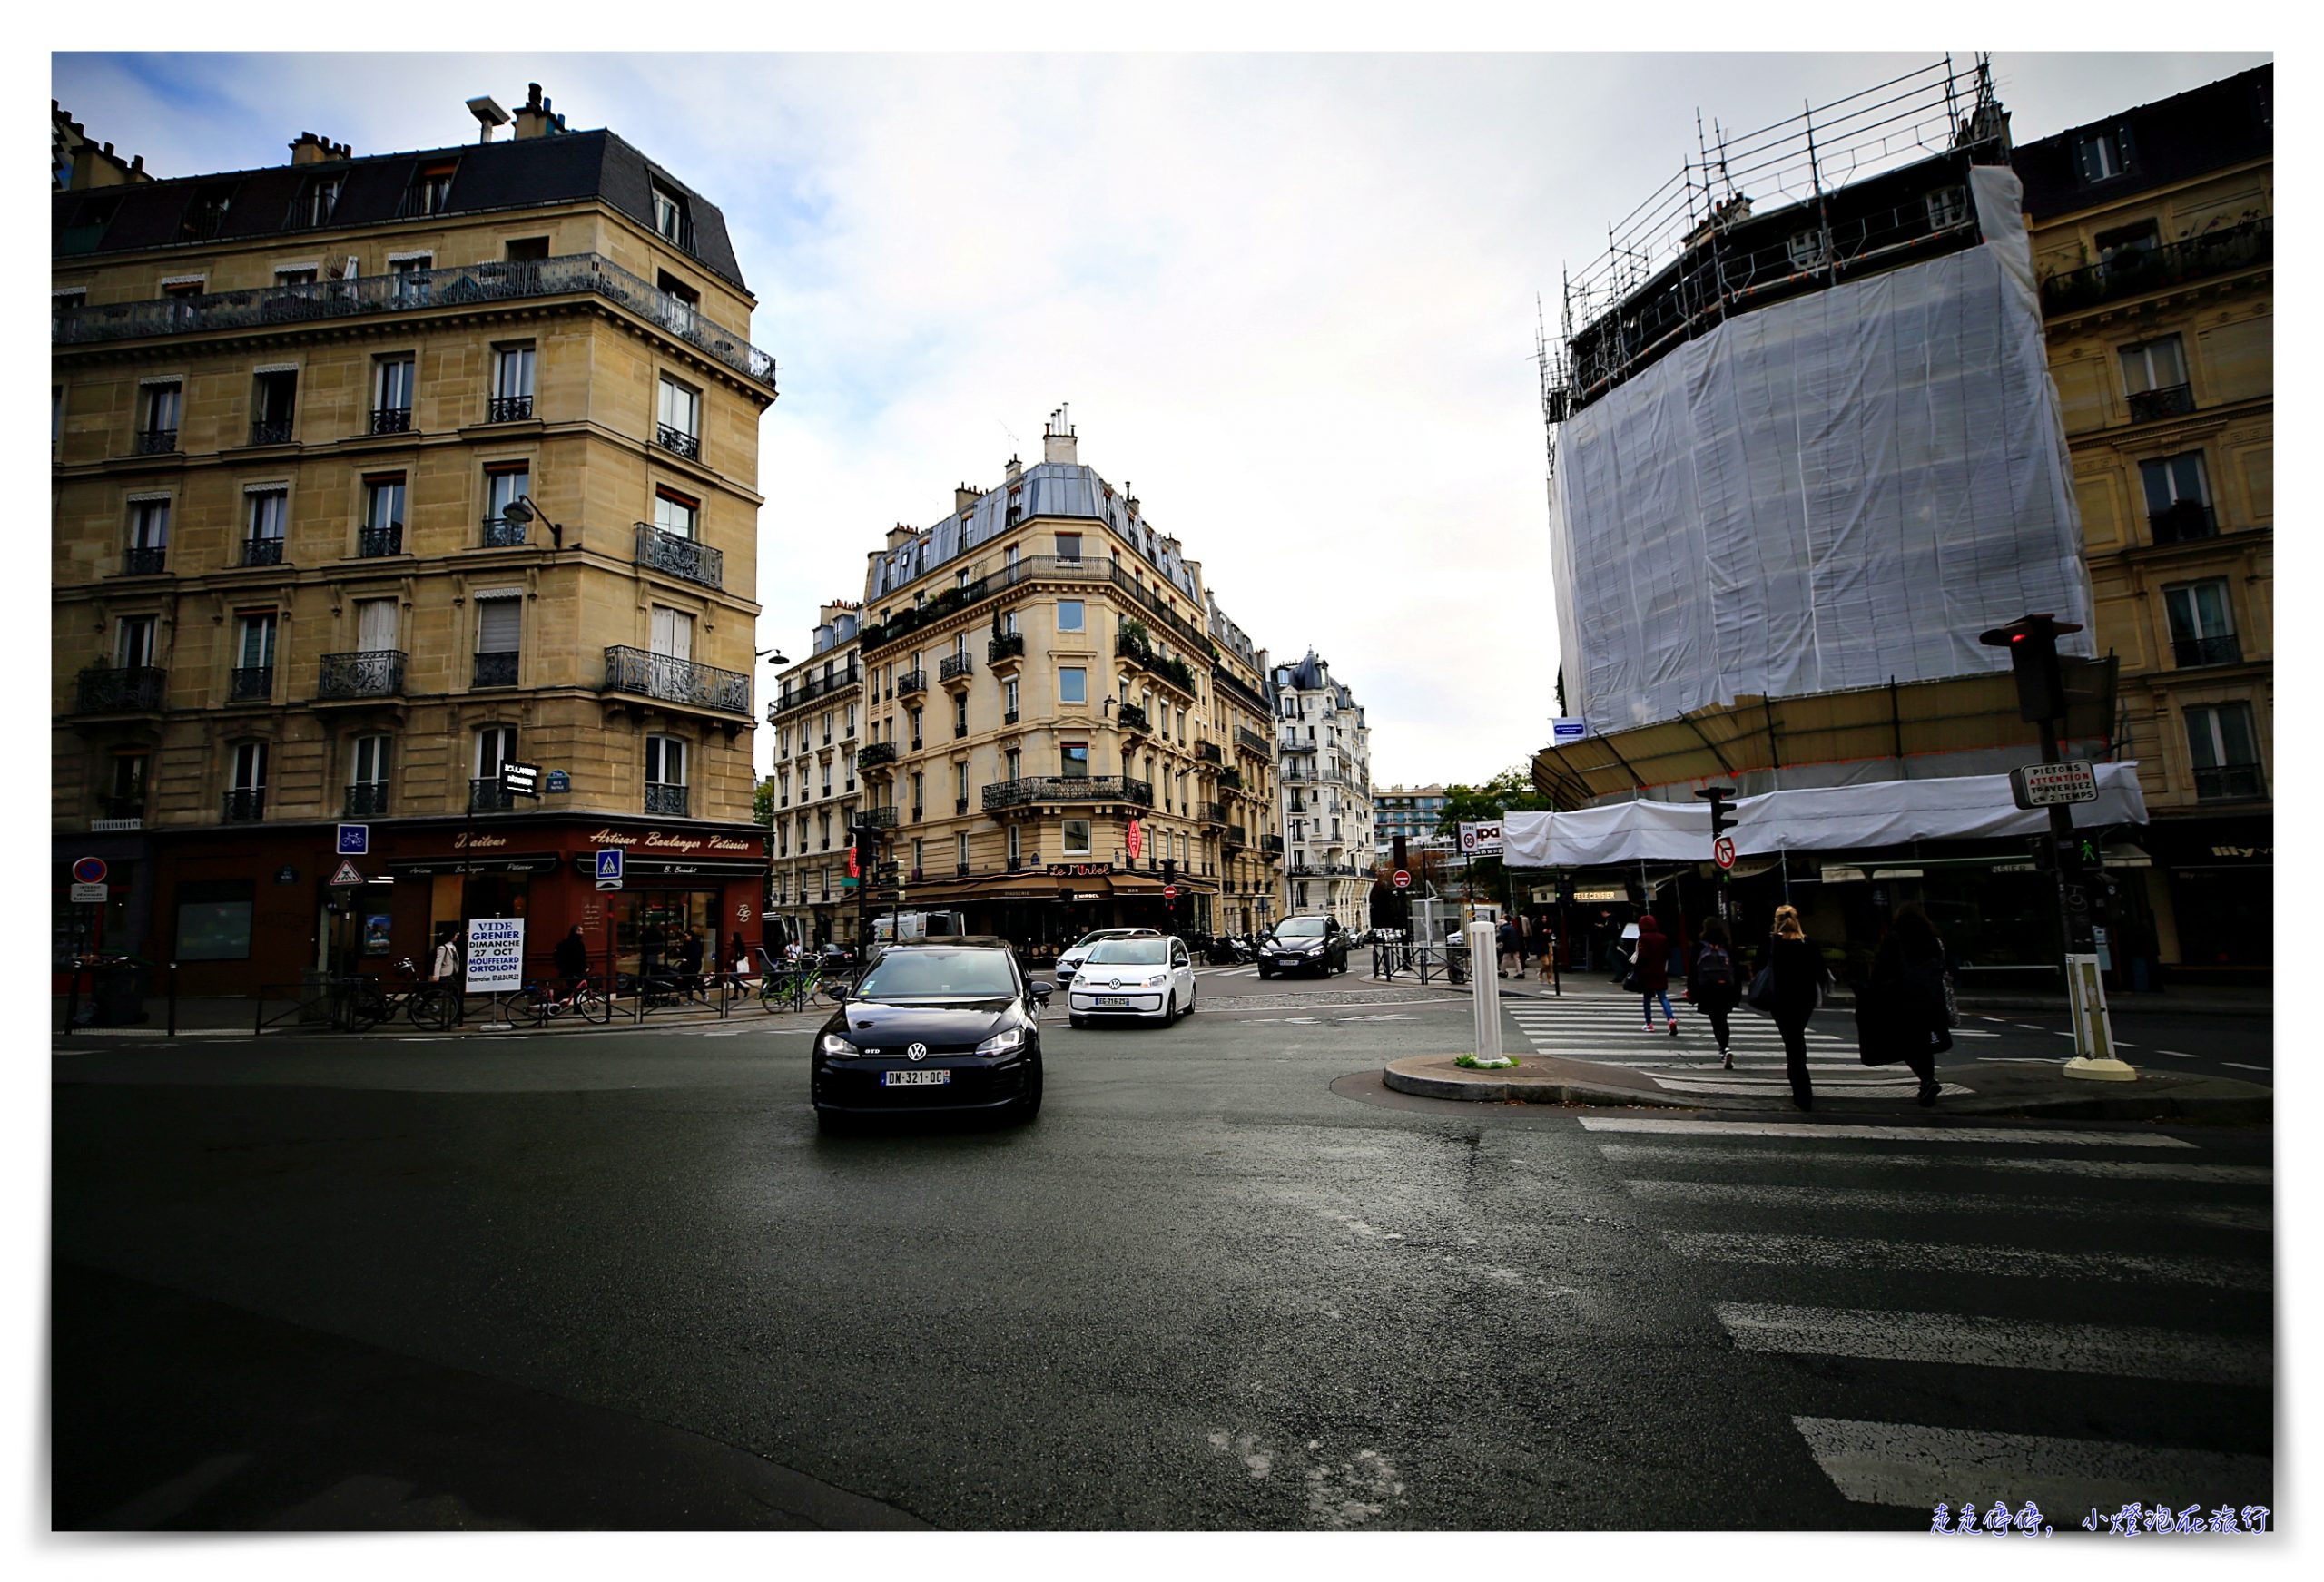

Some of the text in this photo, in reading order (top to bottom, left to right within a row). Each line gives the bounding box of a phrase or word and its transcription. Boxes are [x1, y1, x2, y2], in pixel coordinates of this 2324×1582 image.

[2029, 772, 2090, 786] ATTENTION
[2031, 781, 2092, 794] TRAVERSEZ
[2060, 791, 2093, 801] TEMPS
[454, 831, 507, 849] Taiteur
[590, 827, 638, 846] Artisan
[645, 830, 702, 853] Boulanger
[1049, 864, 1067, 876] Le
[1590, 891, 1615, 899] CENSIER
[478, 921, 513, 931] VIDE
[471, 931, 519, 941] GRENIER
[469, 940, 520, 948] DIMANCHE
[474, 948, 514, 958] 27 OCT
[468, 957, 519, 966] MOUFFETARD
[469, 964, 517, 973] ORTOLON
